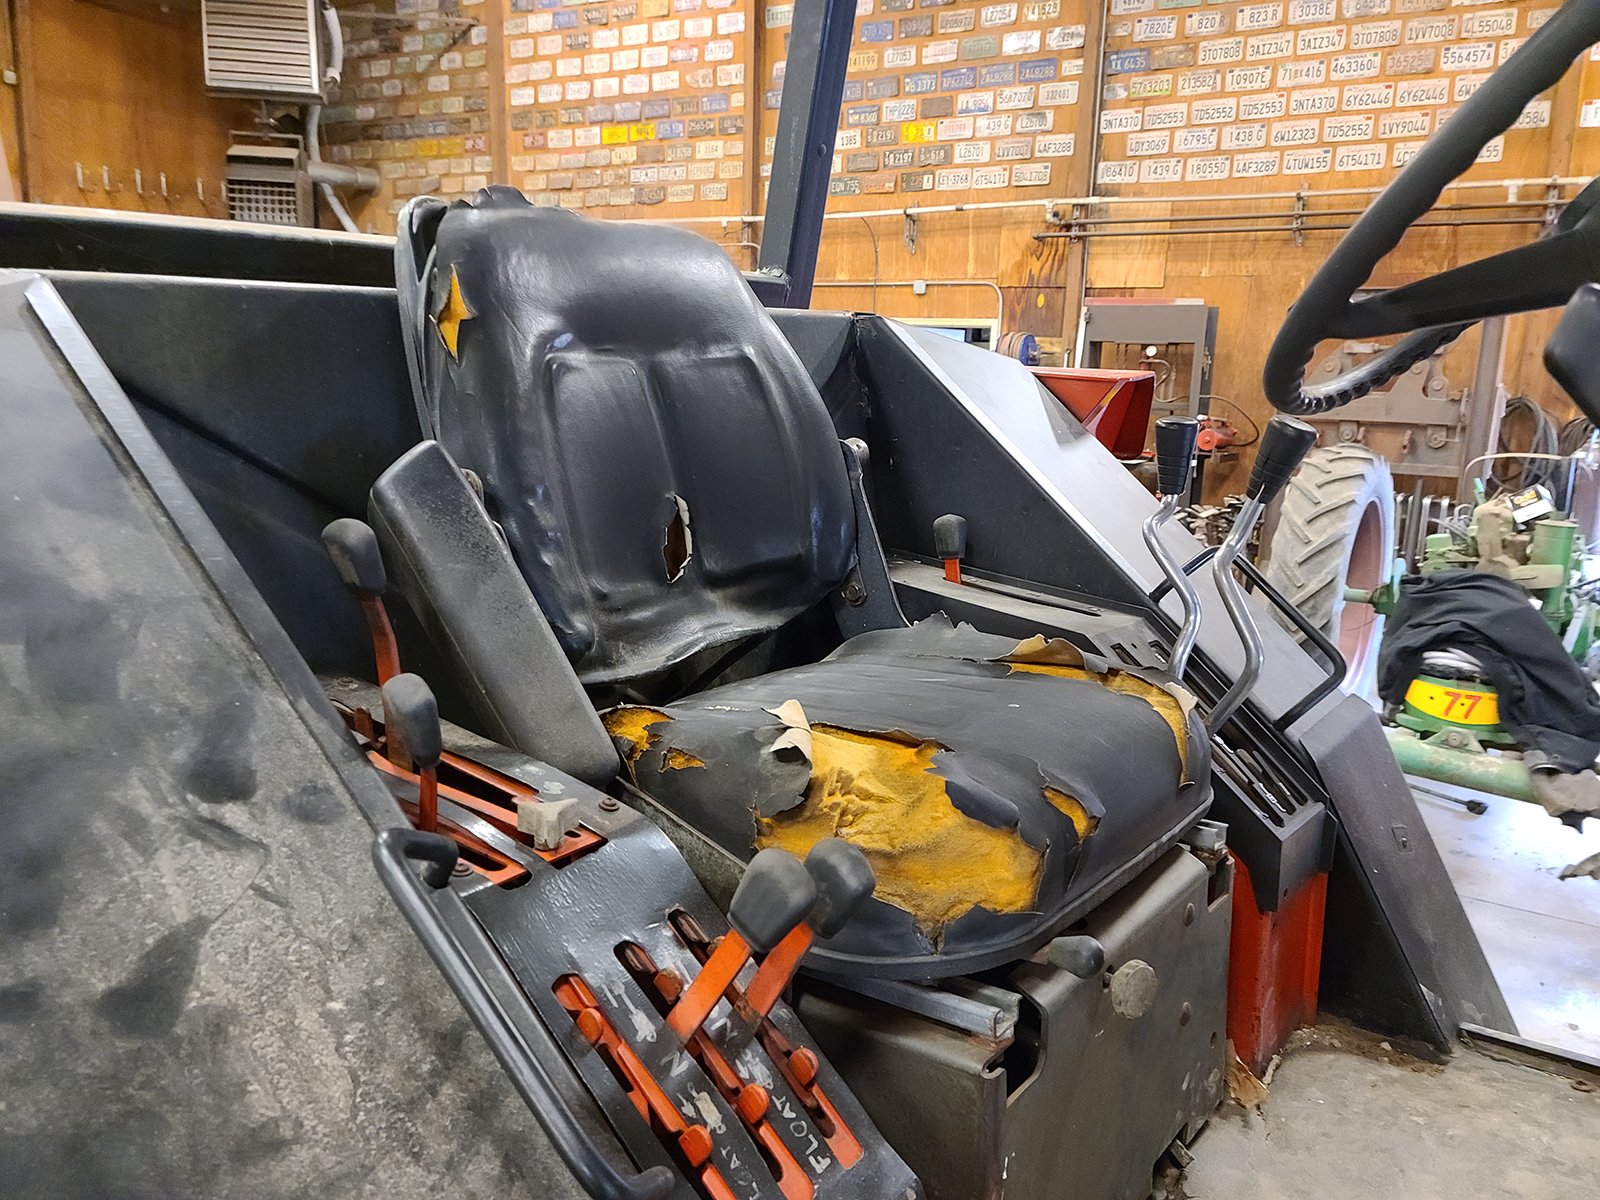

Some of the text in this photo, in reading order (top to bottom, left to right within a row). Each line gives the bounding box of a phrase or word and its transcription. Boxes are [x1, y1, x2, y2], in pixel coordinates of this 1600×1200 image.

[1249, 9, 1279, 23] 823 R
[1298, 2, 1332, 18] 3038E
[1143, 21, 1173, 34] 7820E
[1197, 15, 1226, 30] 820 R
[1463, 18, 1514, 34] 4L55048
[1299, 34, 1344, 51] 3AIZ347
[1353, 29, 1399, 46] 3T07808
[1201, 46, 1241, 61] 3T07808
[1249, 40, 1291, 57] 3AIZ347
[1345, 92, 1391, 107] 6Y62446
[1399, 88, 1446, 103] 6Y62446
[1242, 101, 1284, 117] 7D52553
[1292, 96, 1336, 112] 3NTA370
[1147, 111, 1185, 126] 7D52553
[1194, 106, 1234, 121] 7D52552
[1102, 116, 1140, 131] 3NTA370
[1326, 123, 1371, 138] 7D52552
[1381, 119, 1427, 135] 1VY9044
[1183, 133, 1215, 147] 6795C
[1229, 129, 1264, 143] 1438 G
[1273, 127, 1317, 143] 6W12323
[1037, 141, 1073, 154] 4AF3288
[1129, 138, 1167, 154] 4DY3069
[1235, 160, 1277, 174] 4AF3289
[1285, 156, 1329, 170] 4TUW155
[1338, 153, 1381, 168] 6T54171
[1147, 164, 1179, 177] 1439 G
[1444, 691, 1482, 720] 77
[772, 1095, 832, 1175] FLOAT
